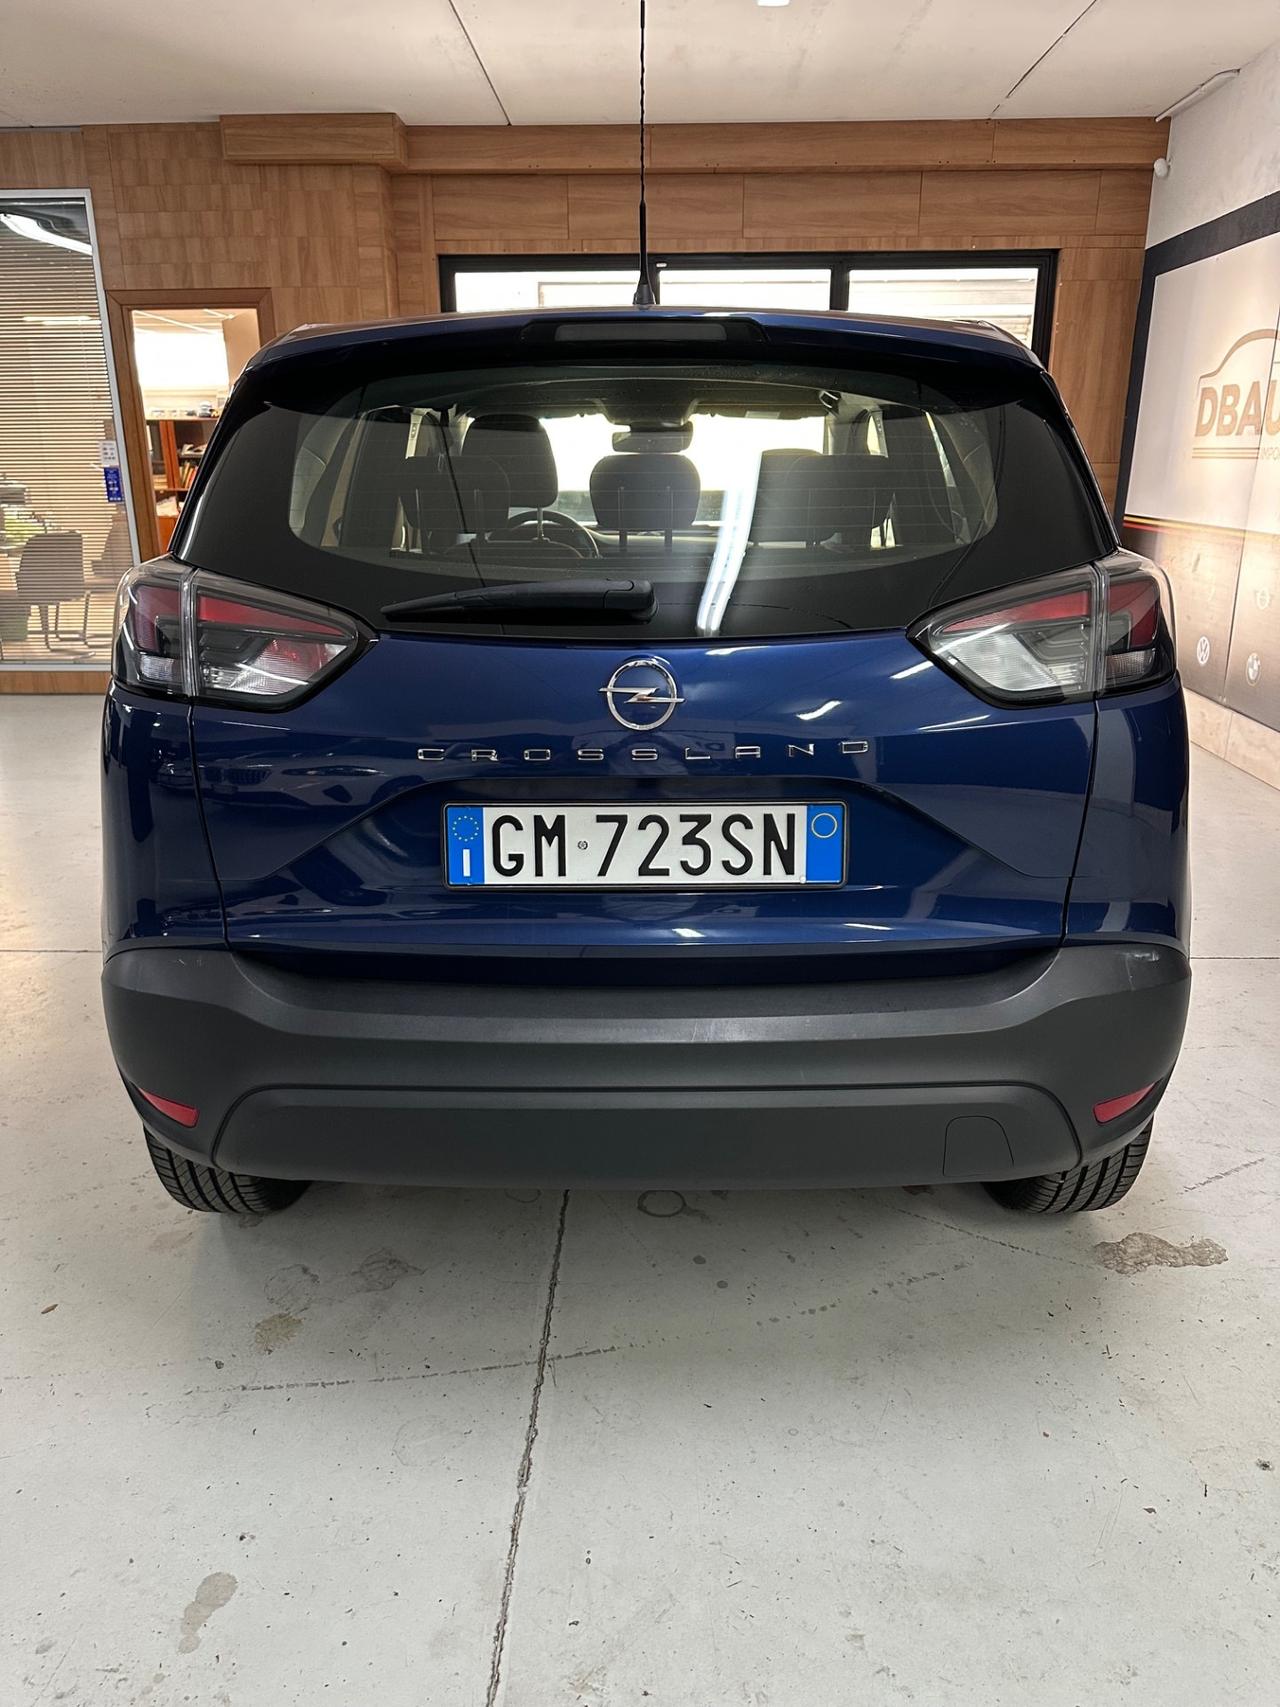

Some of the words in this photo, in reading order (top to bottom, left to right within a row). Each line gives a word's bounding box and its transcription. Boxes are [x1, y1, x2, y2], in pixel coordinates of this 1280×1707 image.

[417, 741, 868, 762] CROSSLAND
[492, 814, 566, 877] GM
[596, 813, 796, 877] 723SN
